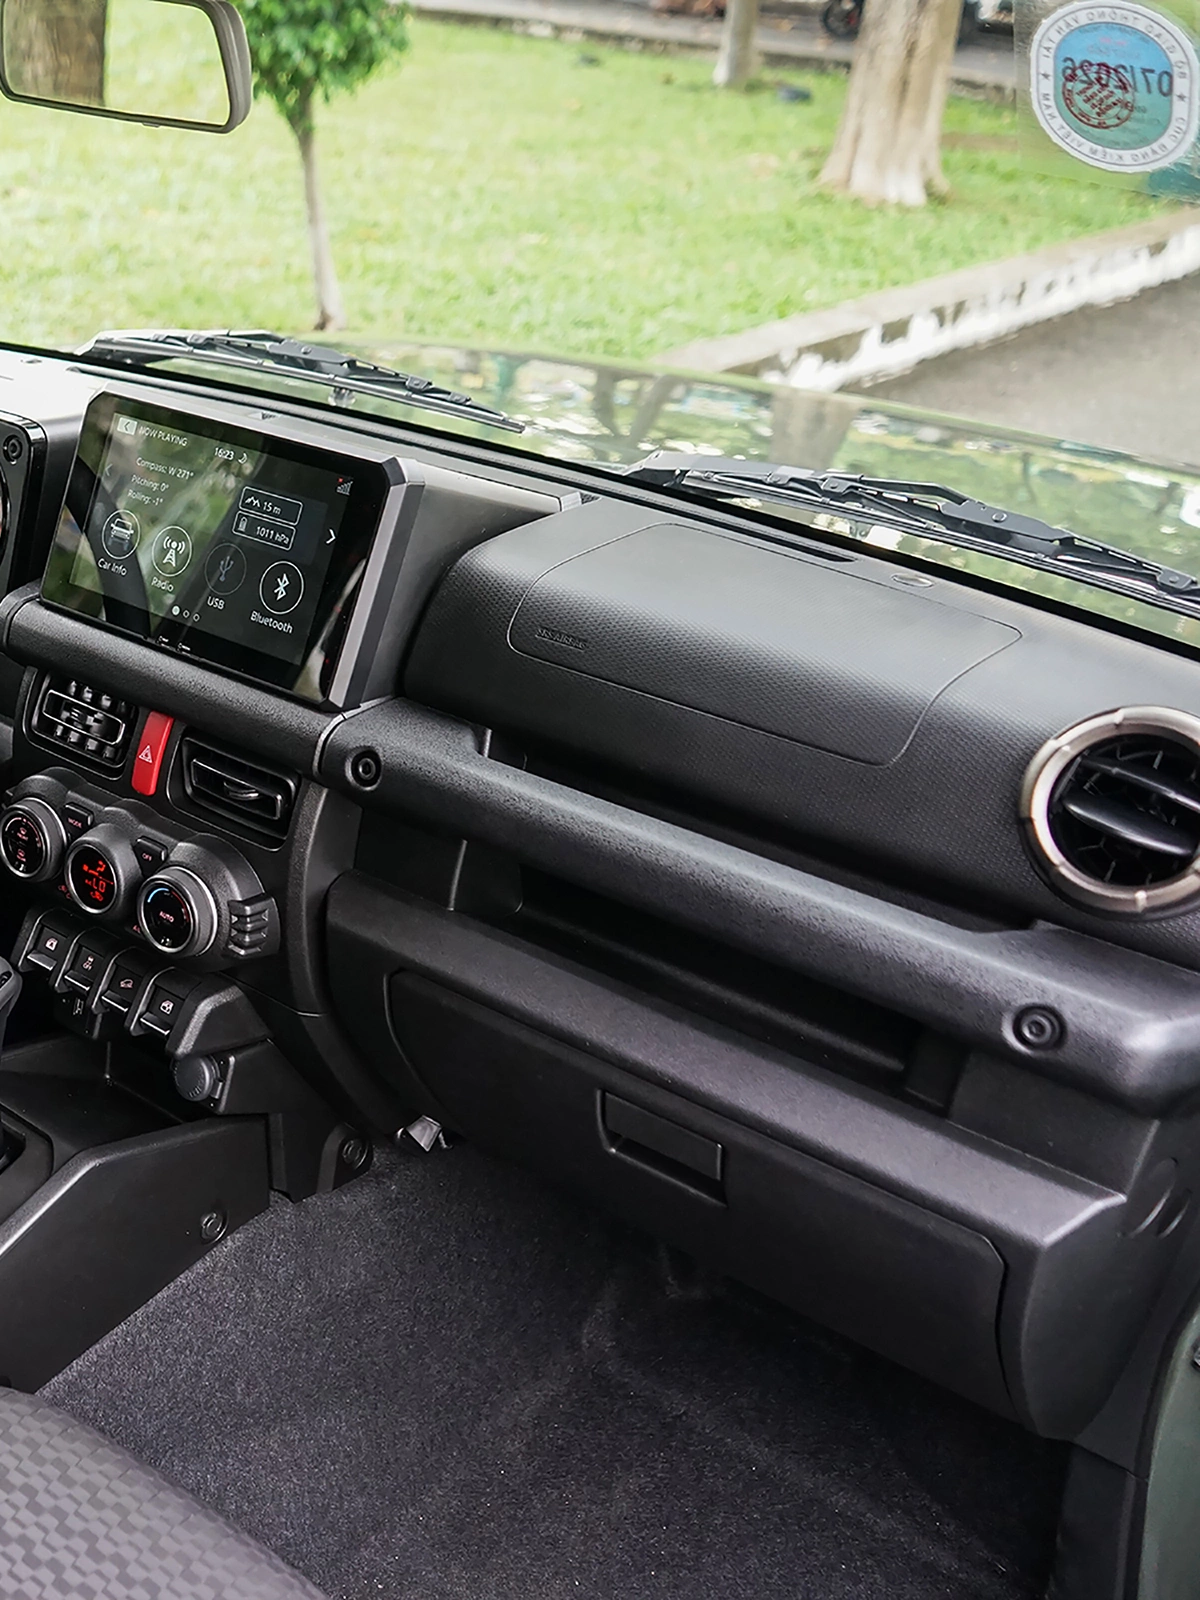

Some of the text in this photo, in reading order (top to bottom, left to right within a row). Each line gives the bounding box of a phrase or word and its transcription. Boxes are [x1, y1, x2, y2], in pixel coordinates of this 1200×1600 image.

[139, 426, 187, 446] NOW PLAYING
[214, 447, 235, 460] 16:23
[263, 501, 272, 512] 15
[256, 526, 289, 544] 1011 hPa
[97, 558, 128, 576] Car Info
[151, 576, 174, 592] Radio
[207, 596, 225, 610] USB
[250, 610, 293, 634] Bluetooth
